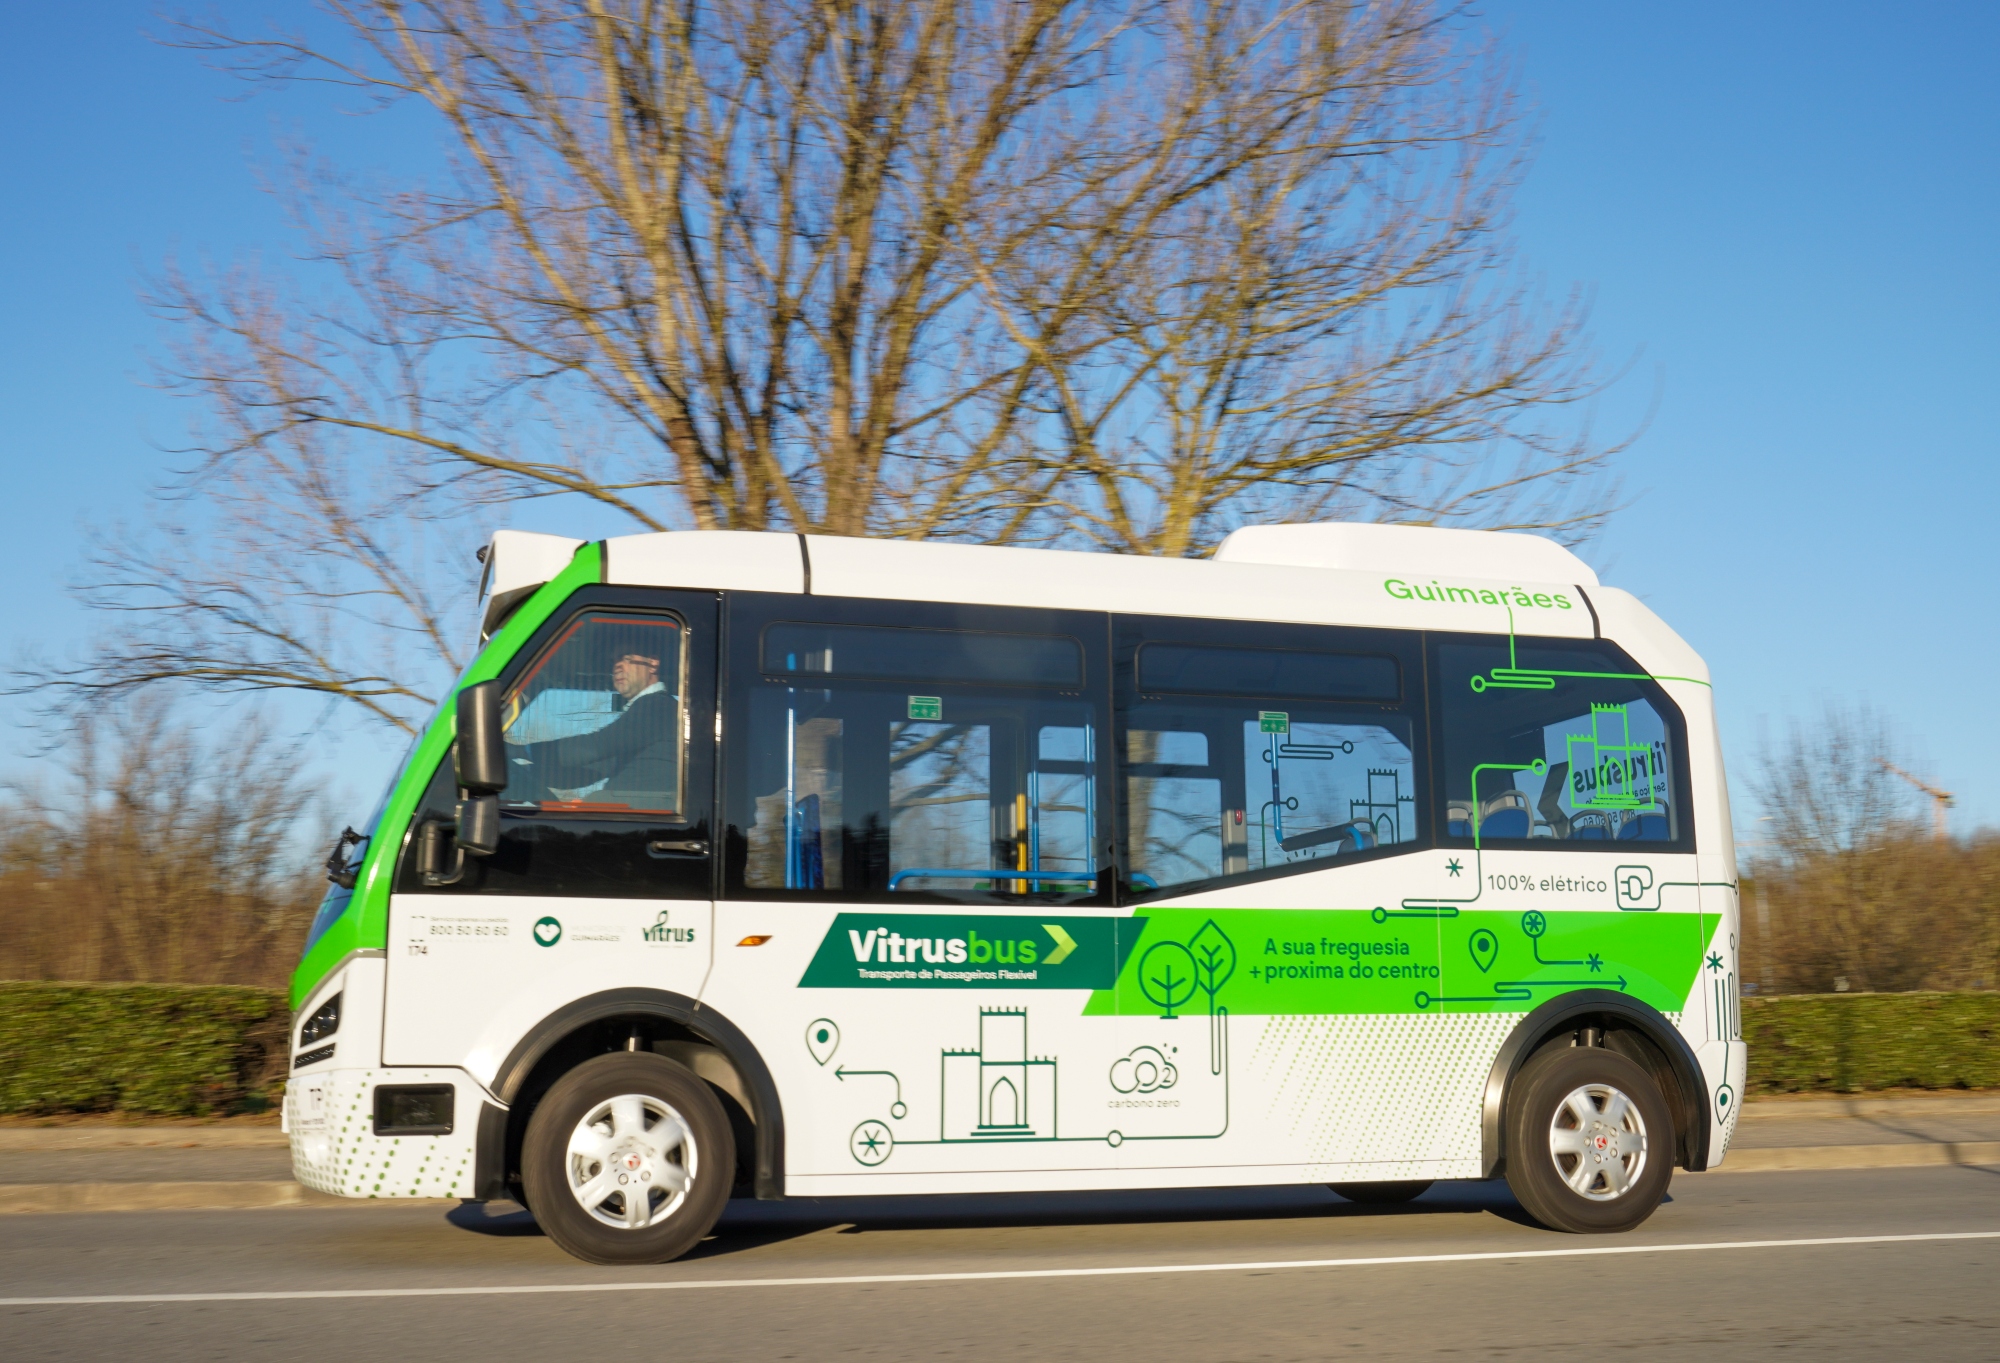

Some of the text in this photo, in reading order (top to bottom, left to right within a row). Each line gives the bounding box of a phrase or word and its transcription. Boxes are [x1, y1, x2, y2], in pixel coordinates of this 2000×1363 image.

[1384, 579, 1572, 610] Guimarães
[1488, 874, 1608, 893] 100% elétrico
[848, 927, 1037, 964] Vitrusbus
[1264, 938, 1410, 961] A sua freguesia
[857, 968, 917, 981] Transporte
[917, 969, 934, 979] de
[934, 969, 997, 982] Passageiros
[1265, 961, 1344, 983] proxima
[1349, 961, 1374, 979] do
[1378, 963, 1440, 979] centro
[1107, 1099, 1181, 1108] carbono zero
